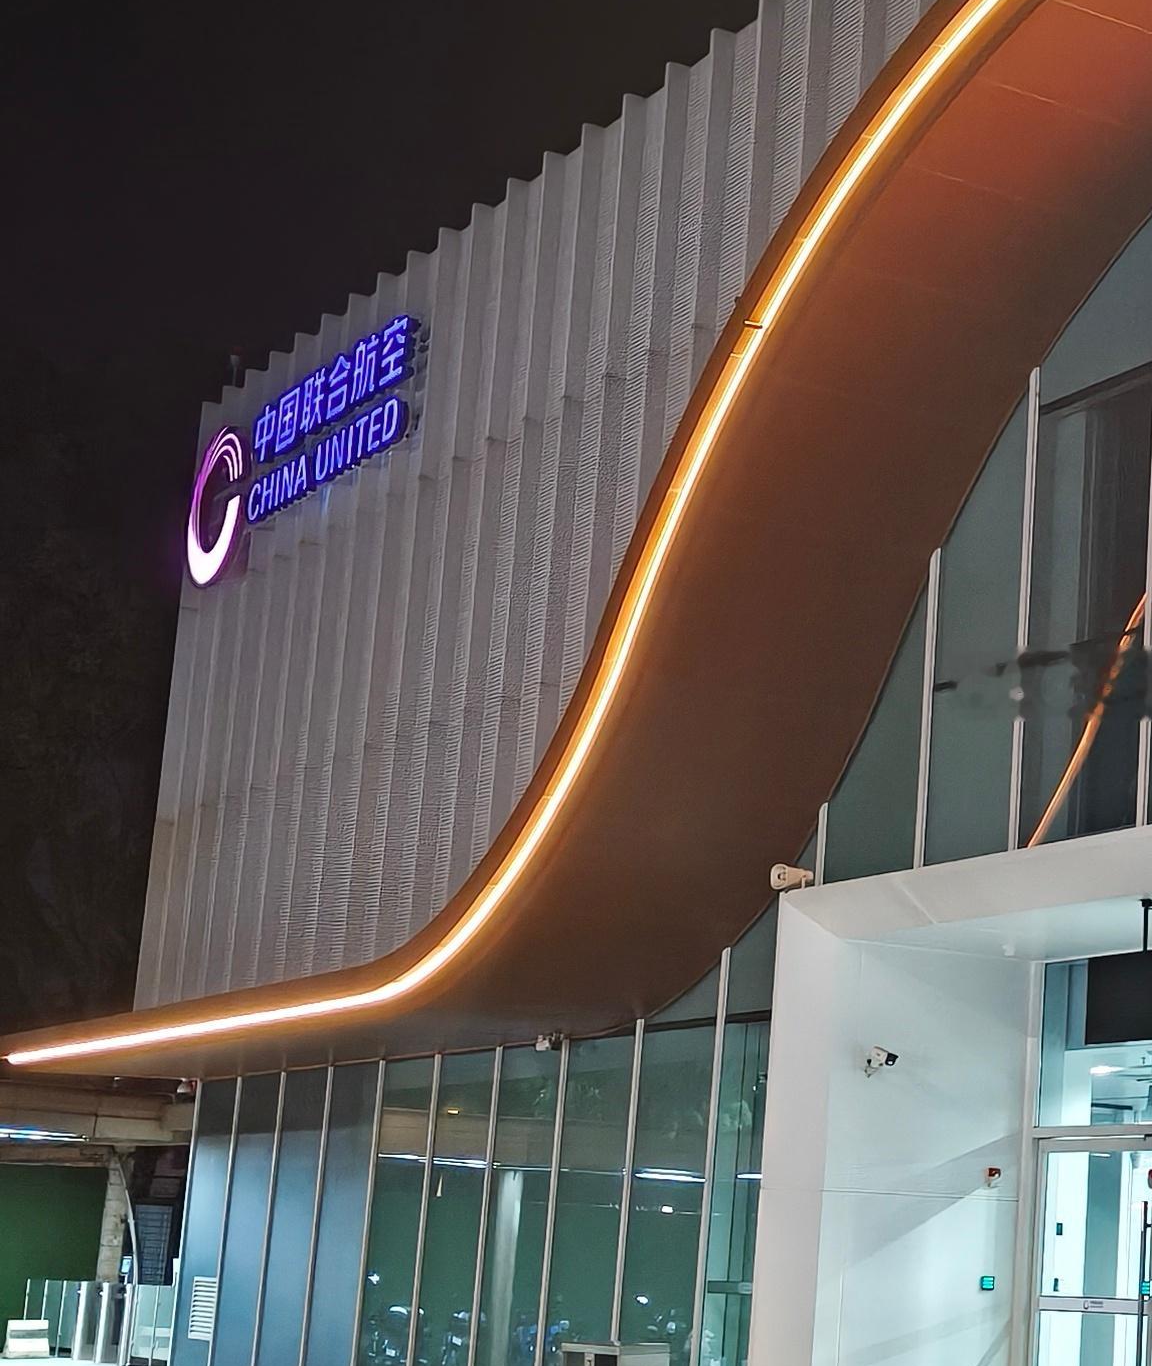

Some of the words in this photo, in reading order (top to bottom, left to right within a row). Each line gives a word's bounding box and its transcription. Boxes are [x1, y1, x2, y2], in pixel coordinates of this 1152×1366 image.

[254, 317, 408, 463] 中国联合航空
[247, 455, 307, 523] CHINA
[315, 398, 398, 481] UNITED
